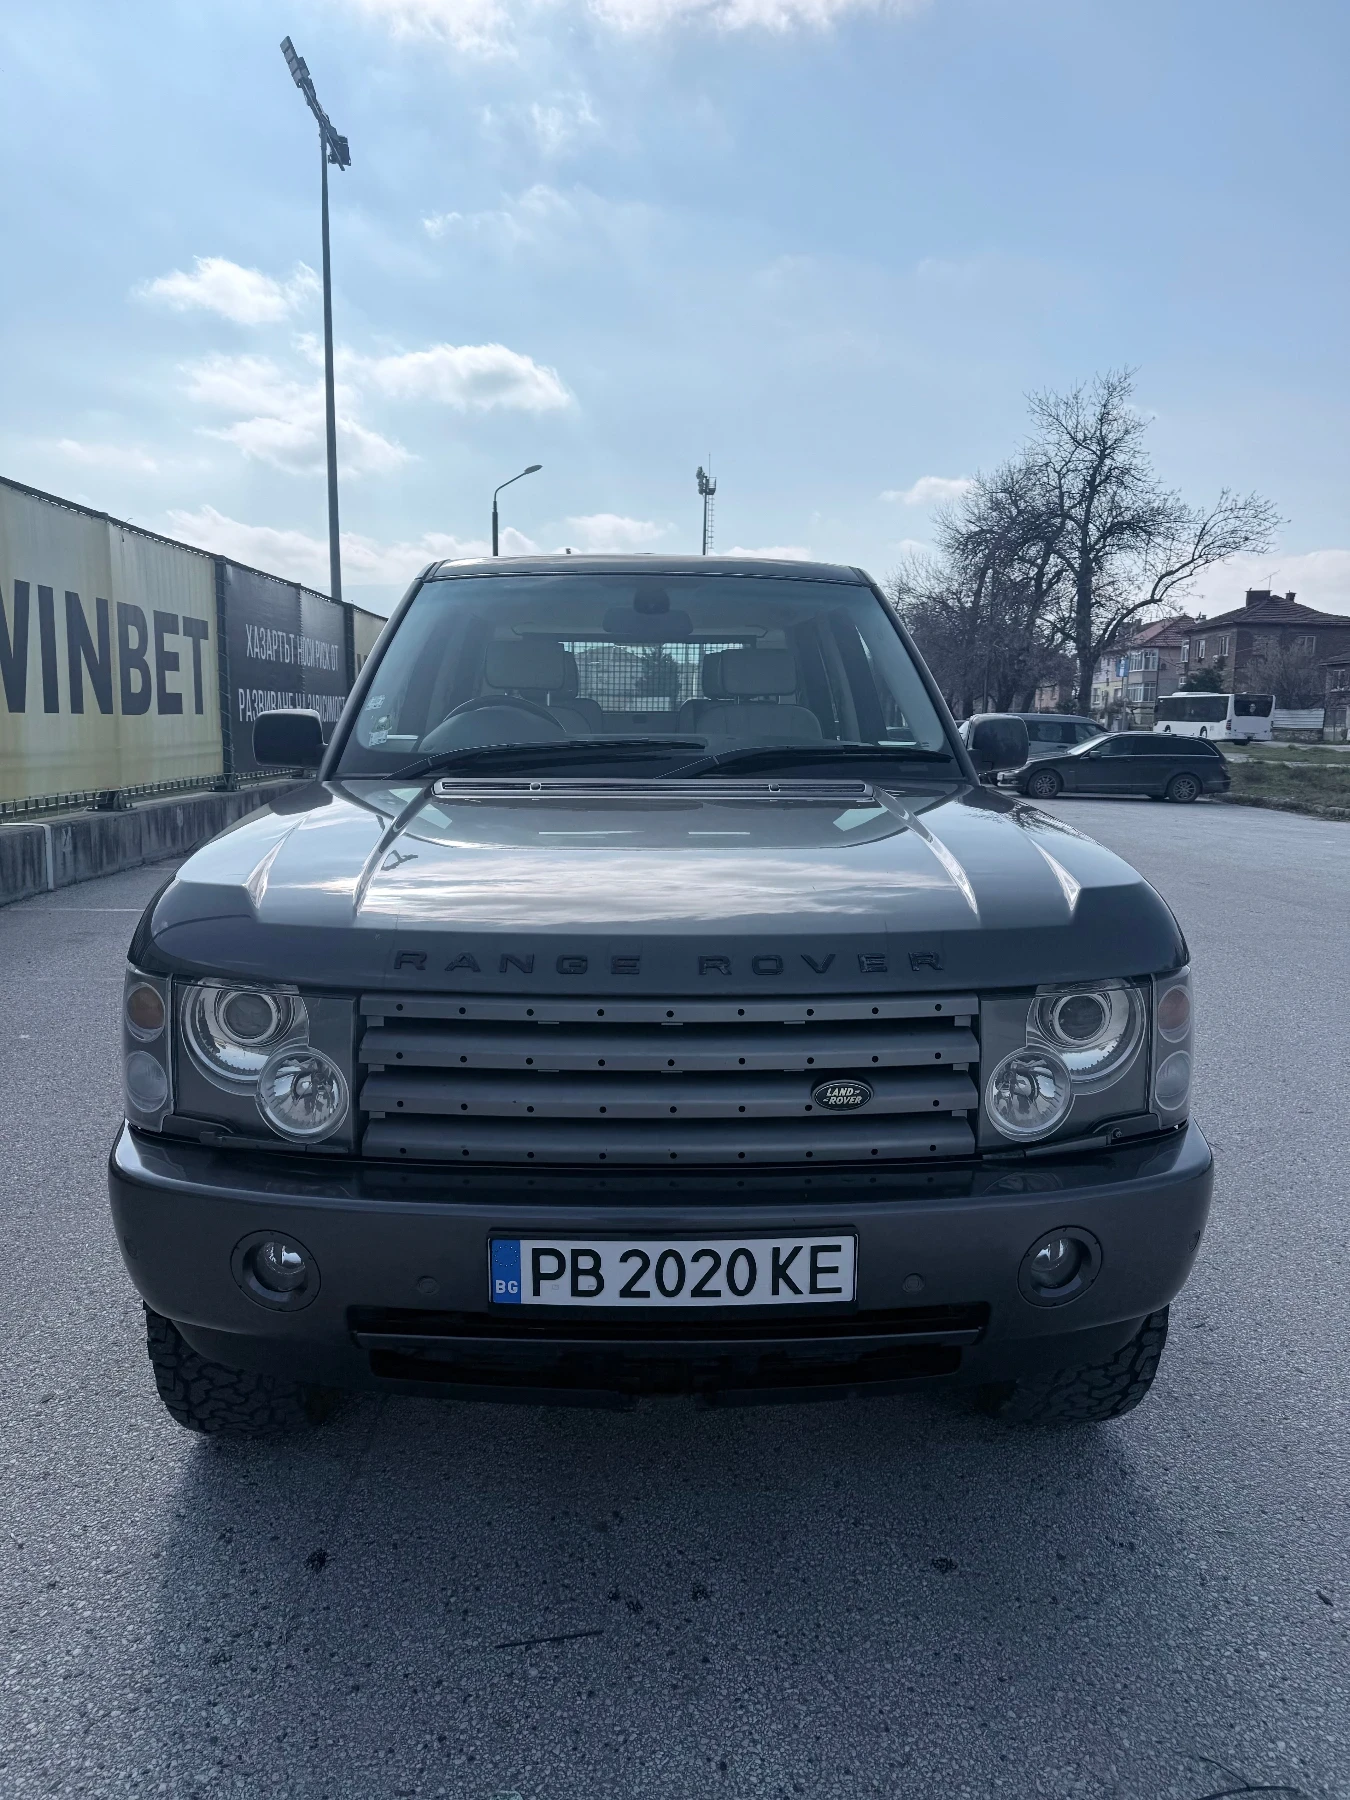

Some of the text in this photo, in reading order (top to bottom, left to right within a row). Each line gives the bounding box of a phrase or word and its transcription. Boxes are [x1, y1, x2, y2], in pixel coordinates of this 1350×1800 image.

[245, 623, 295, 665] ХАЗАРТЪТ
[331, 644, 339, 672] ОТ
[393, 950, 945, 976] RANGE ROVER
[826, 1087, 854, 1097] LAND
[828, 1096, 863, 1105] ROVER
[531, 1244, 843, 1298] PB 2020 KE
[495, 1279, 518, 1294] BG
